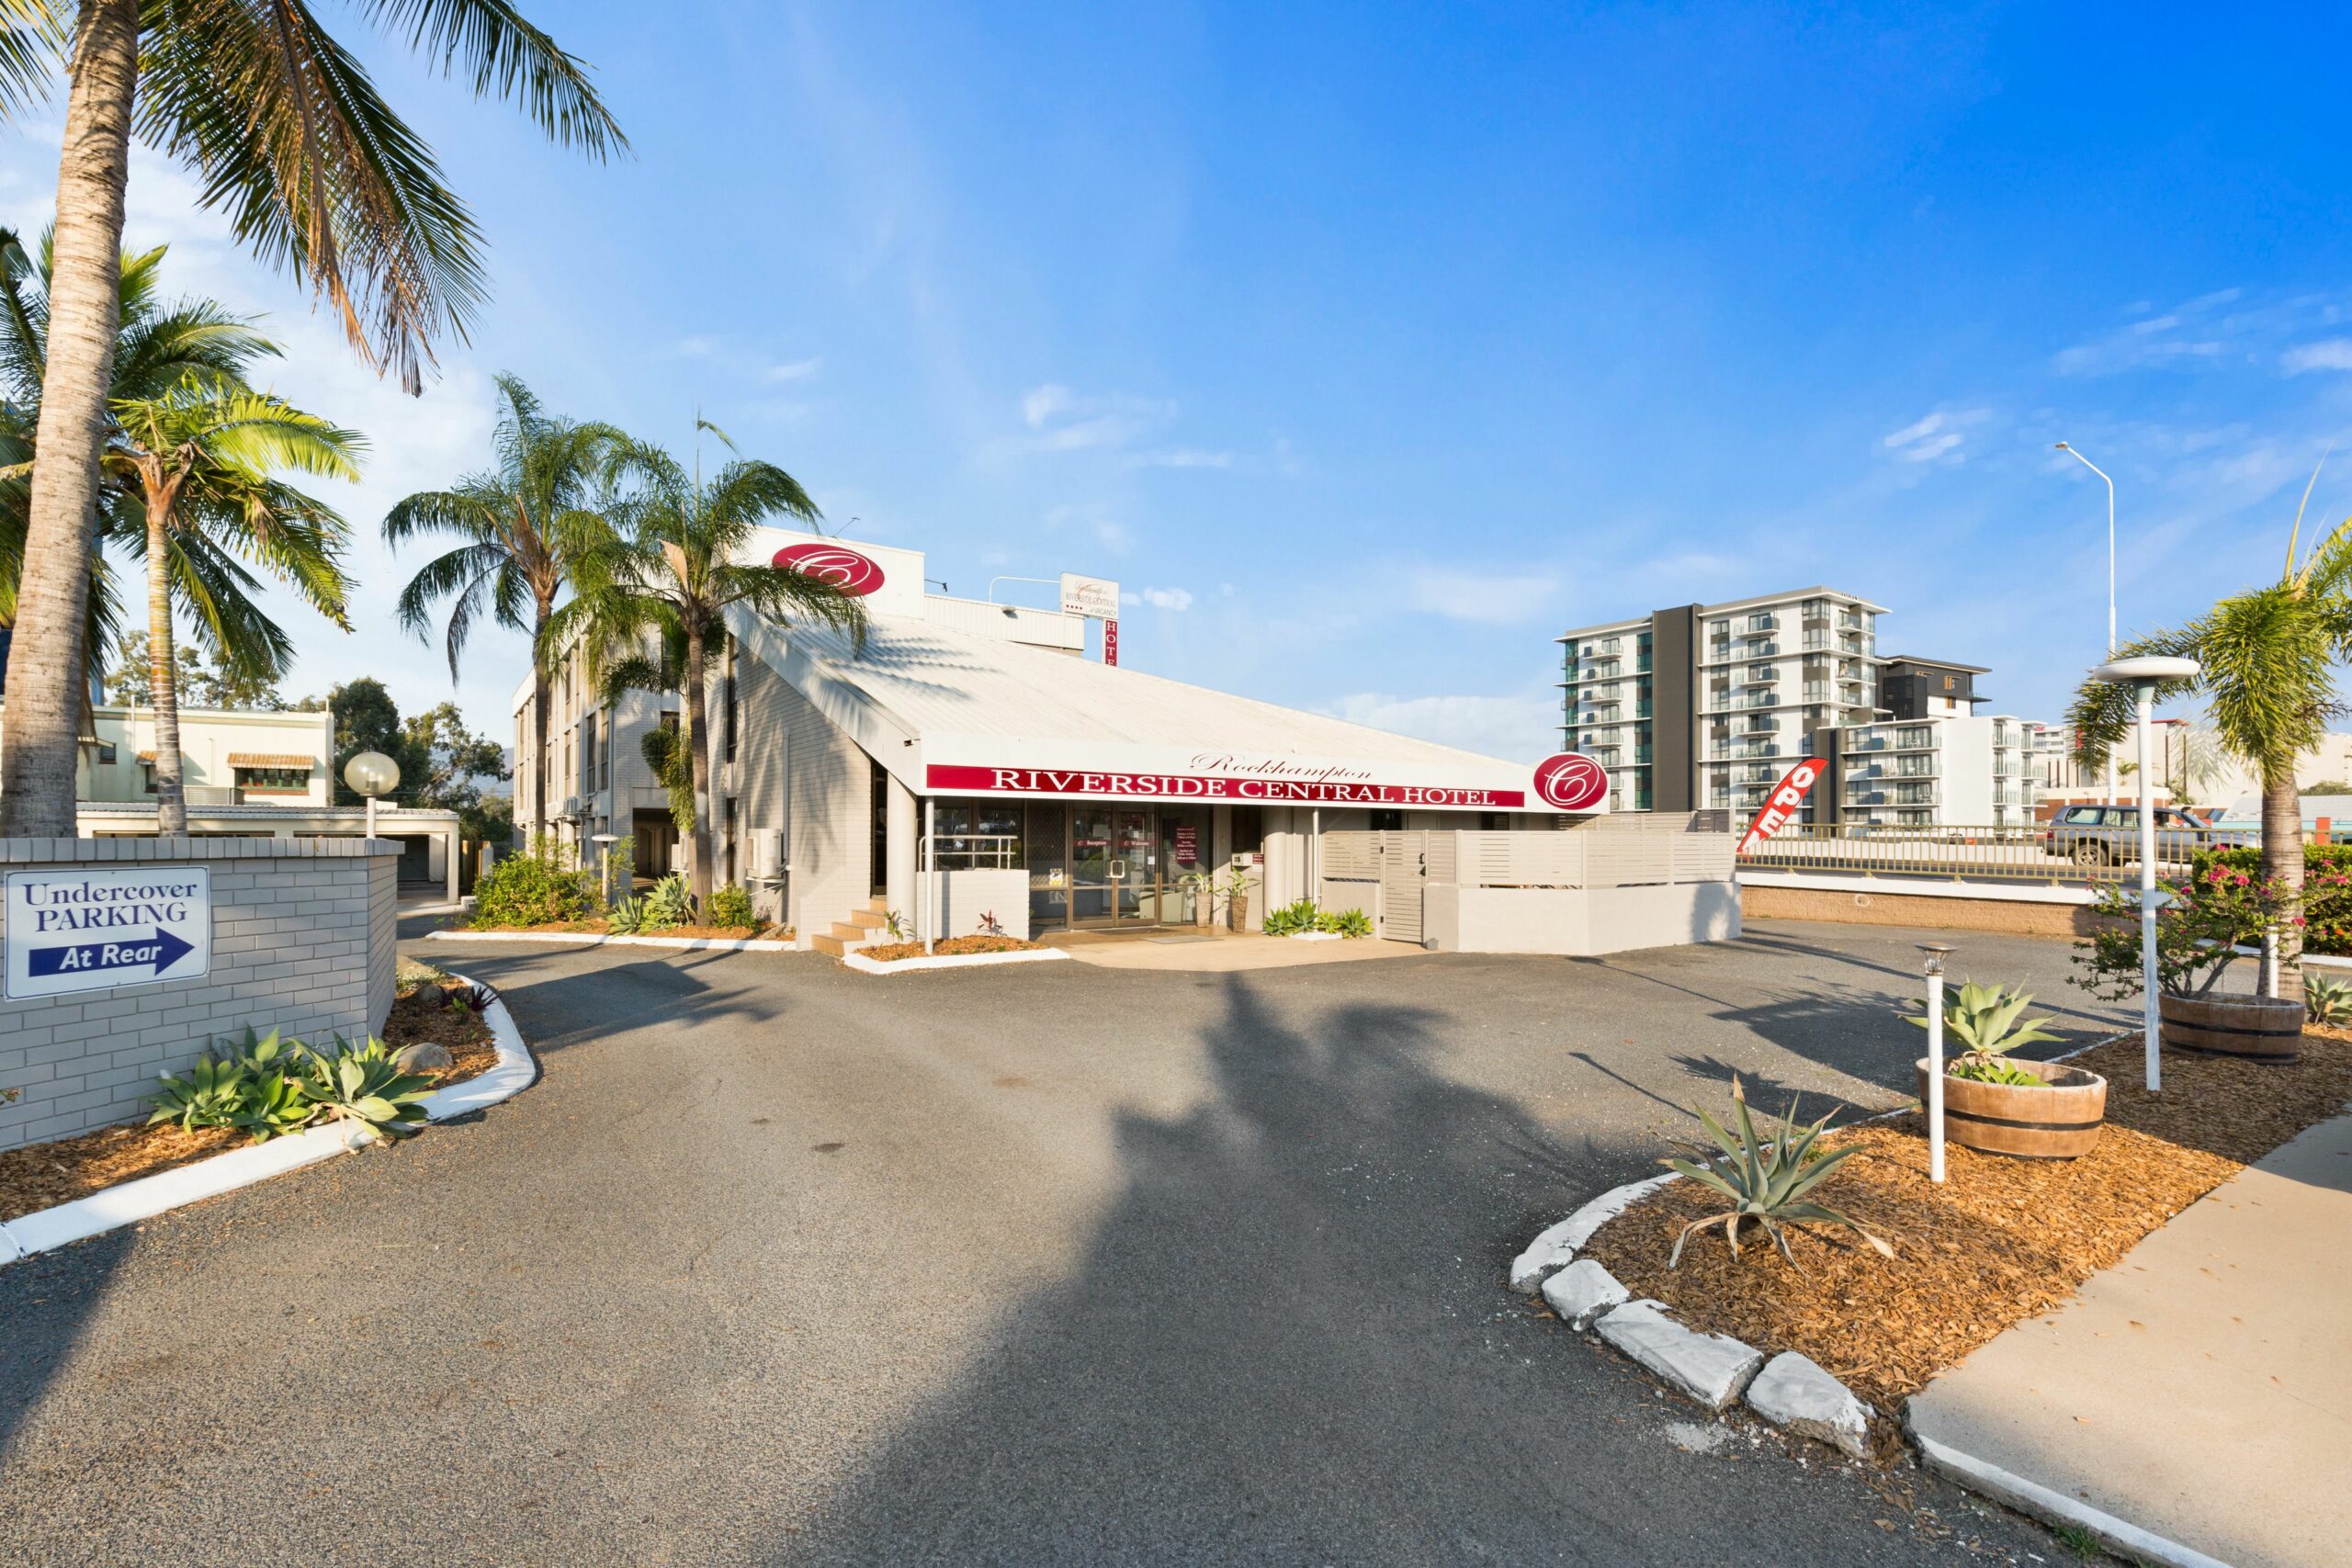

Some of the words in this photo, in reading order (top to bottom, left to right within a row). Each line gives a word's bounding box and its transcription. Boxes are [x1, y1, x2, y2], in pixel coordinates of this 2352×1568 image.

[1106, 621, 1117, 667] HOTE
[1190, 751, 1373, 784] Rockhampton
[990, 769, 1227, 797] RIVERSIDE
[1238, 780, 1395, 803] CENTRAL
[1403, 786, 1497, 807] HOTEL
[23, 881, 198, 906] Undercover
[35, 901, 188, 932] PARKING
[59, 947, 93, 970] At
[100, 943, 163, 965] Rear
